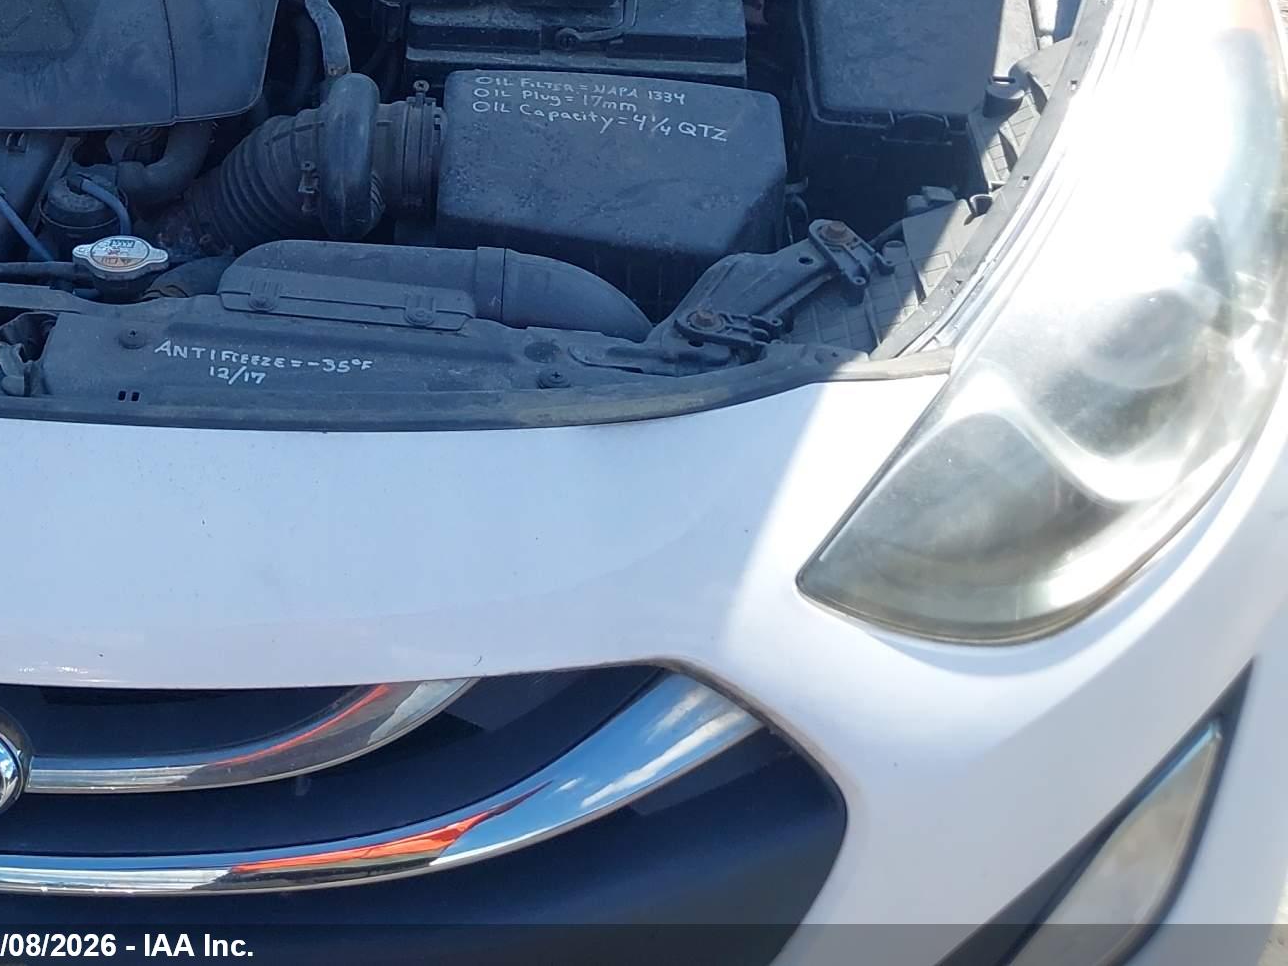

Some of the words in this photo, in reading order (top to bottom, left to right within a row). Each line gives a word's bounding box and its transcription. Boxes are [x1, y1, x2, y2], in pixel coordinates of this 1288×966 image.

[473, 88, 513, 98] OIL
[522, 89, 561, 107] Plug
[583, 94, 637, 113] 17mm
[475, 76, 514, 86] OIL
[592, 84, 638, 98] NAPA
[648, 90, 686, 105] 1334
[472, 100, 511, 113] OIL
[519, 103, 614, 134] Capacity
[678, 121, 728, 142] QTZ
[209, 365, 267, 385] 12/17
